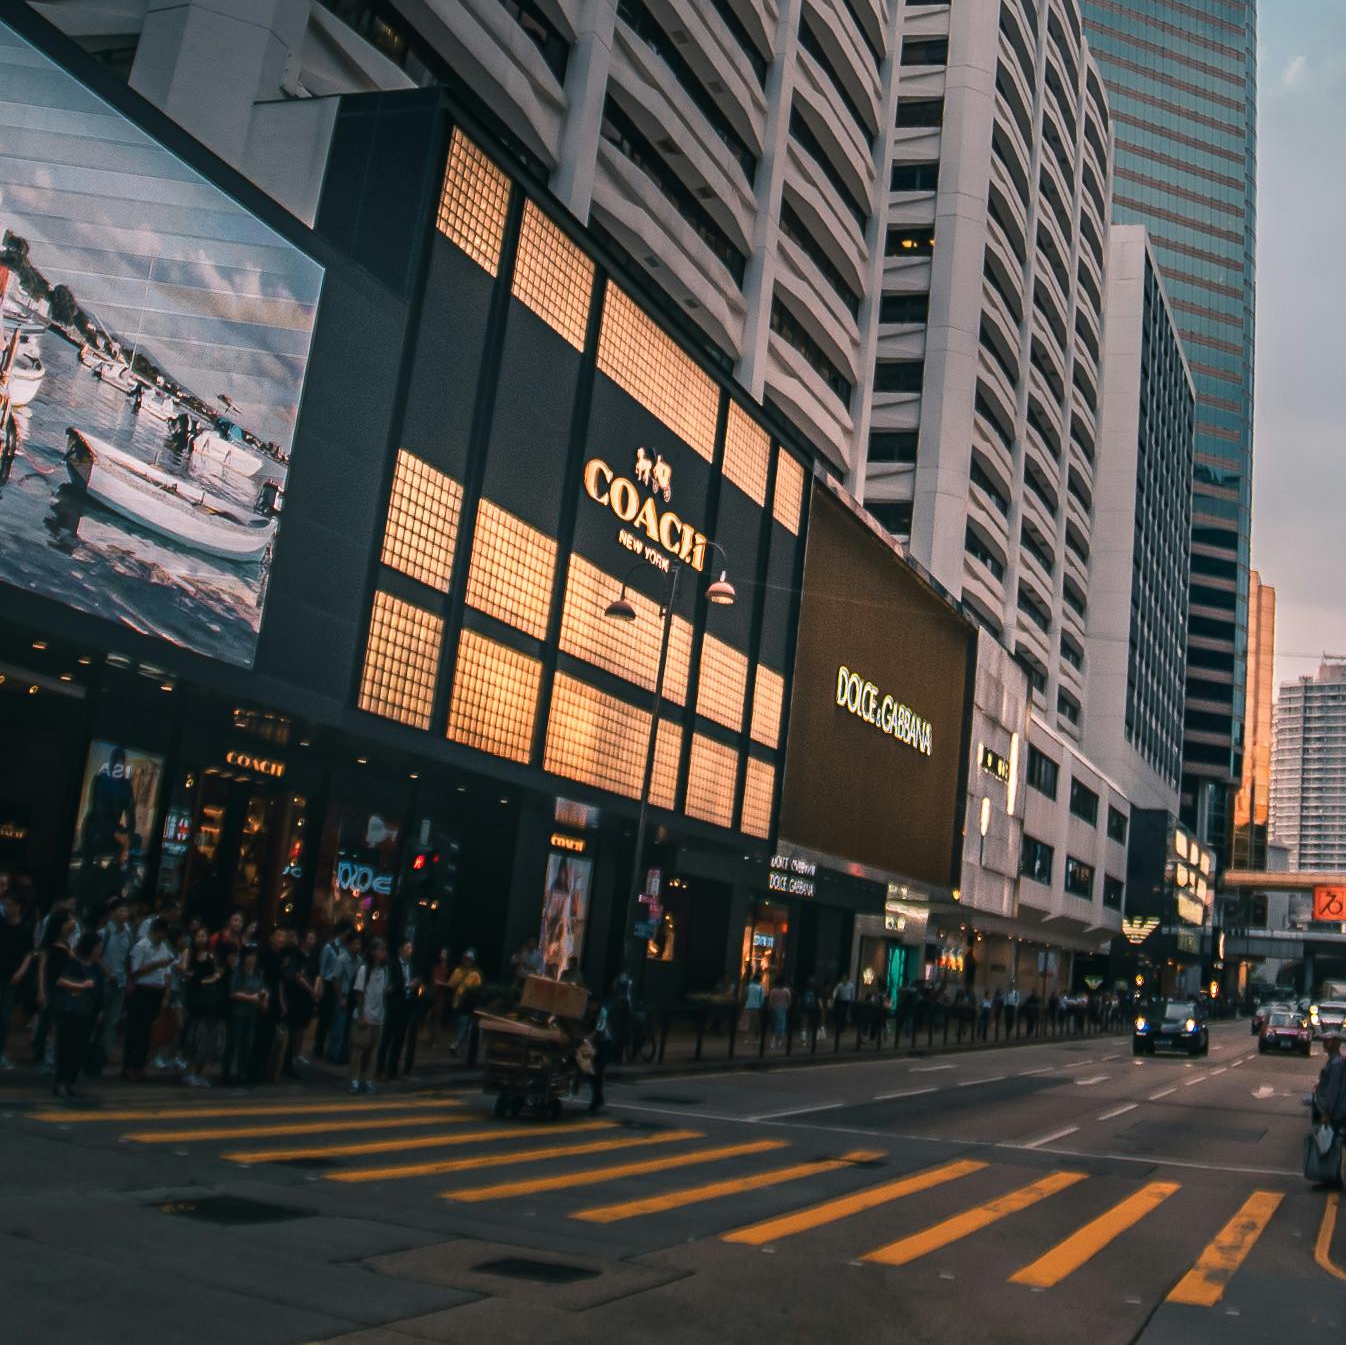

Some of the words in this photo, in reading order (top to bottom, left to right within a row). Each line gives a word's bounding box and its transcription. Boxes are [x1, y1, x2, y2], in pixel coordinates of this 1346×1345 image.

[583, 458, 708, 573] COACH
[618, 528, 643, 555] NEW
[643, 545, 670, 574] YORK
[225, 749, 287, 779] COACH
